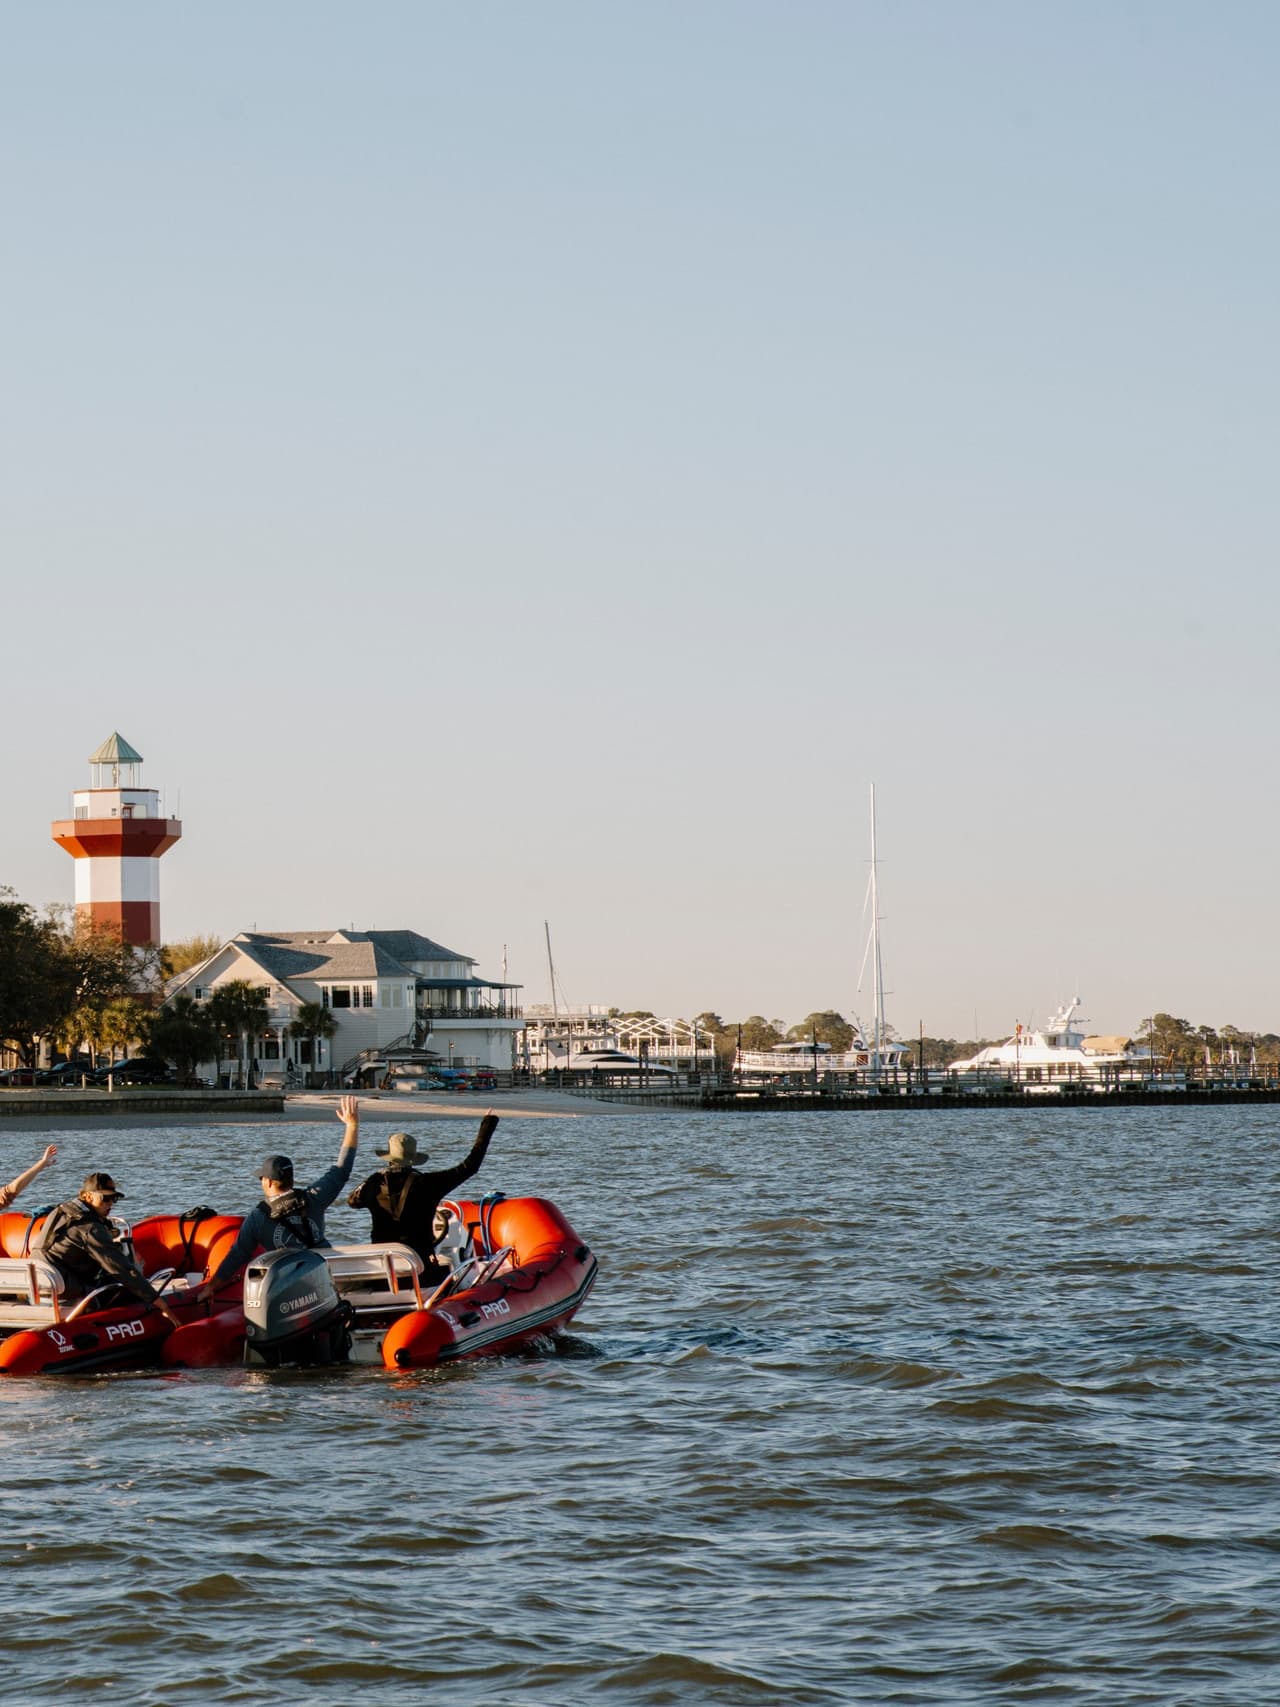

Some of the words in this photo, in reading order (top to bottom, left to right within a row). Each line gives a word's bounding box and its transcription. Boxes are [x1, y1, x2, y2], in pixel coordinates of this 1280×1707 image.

[247, 1300, 261, 1308] 50
[289, 1292, 318, 1311] YAMAHA
[480, 1298, 510, 1319] PRO
[106, 1320, 145, 1341] PRO
